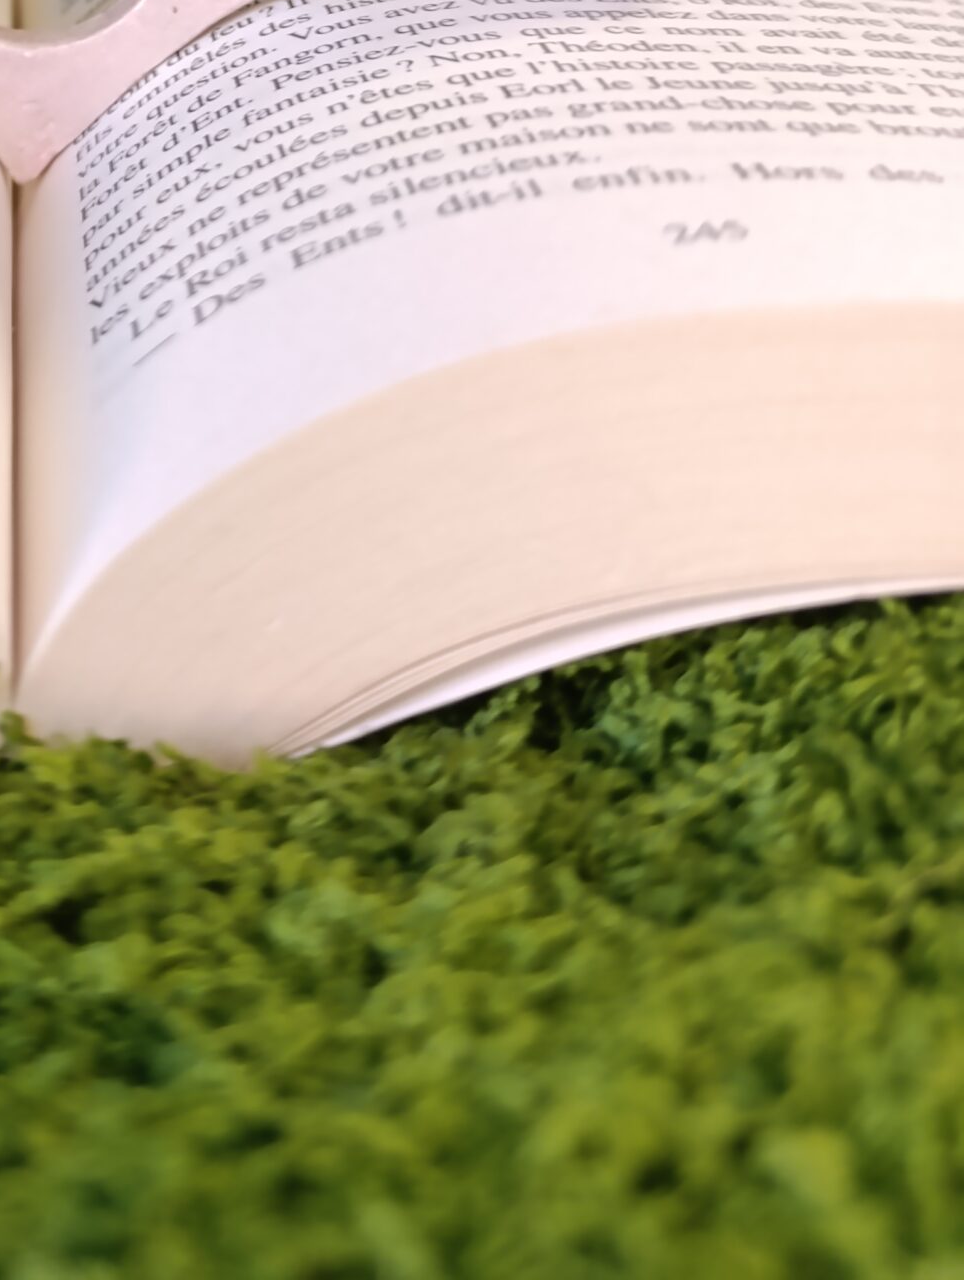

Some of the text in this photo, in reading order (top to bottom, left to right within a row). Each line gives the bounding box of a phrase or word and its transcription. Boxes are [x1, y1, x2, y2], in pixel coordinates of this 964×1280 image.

[74, 125, 114, 165] fils
[122, 37, 247, 121] emmêlés
[258, 11, 312, 38] des
[77, 122, 139, 179] votre
[145, 45, 278, 121] question.
[288, 15, 374, 41] Vous
[383, 0, 461, 19] avez
[78, 6, 792, 201] la Forêt de Fangorn, que vous appelez dans
[81, 24, 849, 223] Forêt d'Ent. Pensiez-vous que ce nom avait
[208, 17, 254, 43] feu
[82, 38, 806, 250] par simple fantaisie Non, Théoden, il en
[83, 58, 701, 275] pour vous n'êtes que l'histoire
[86, 75, 758, 293] années écoulées depuis Eorl le Jeune
[88, 95, 817, 310] Vieux ne représentent pas grand-chose
[90, 119, 864, 346] les exploits de votre maison ne sont que
[131, 149, 603, 342] Le Roi resta silencieux.
[192, 271, 268, 327] Des
[289, 219, 385, 271] Ents
[435, 176, 544, 218] dit-il
